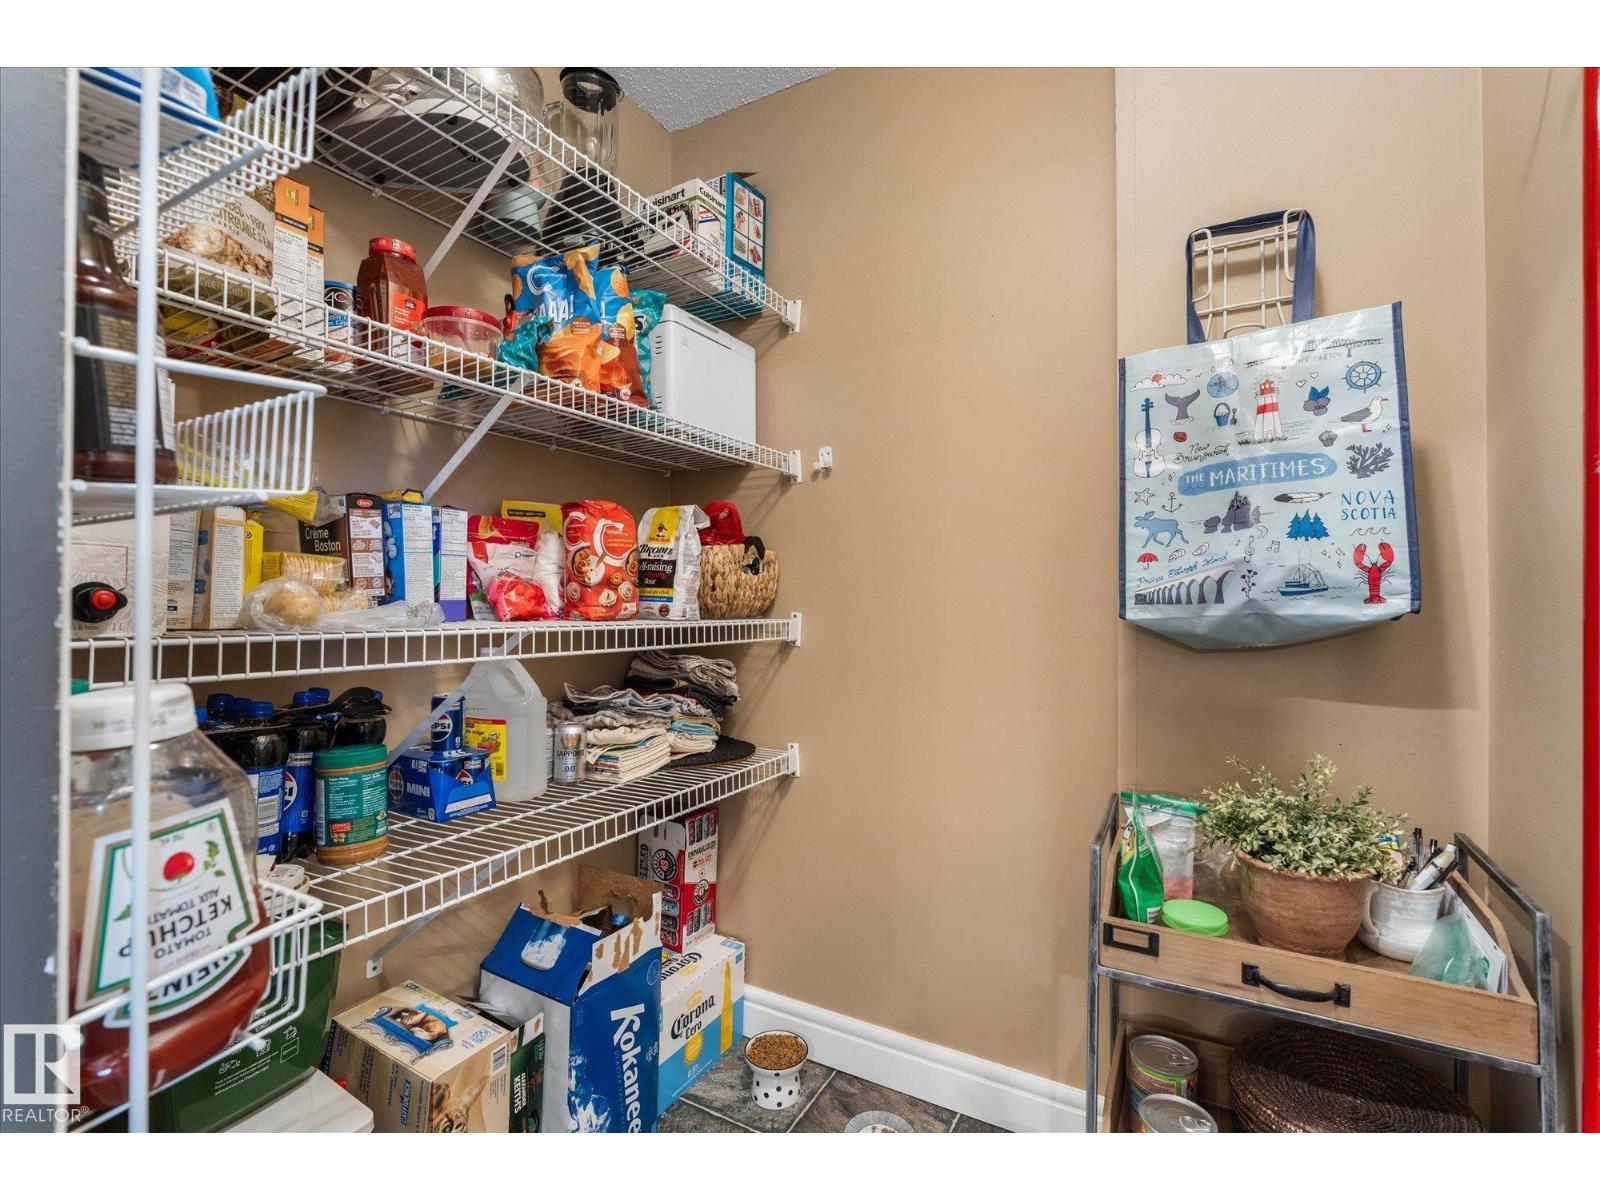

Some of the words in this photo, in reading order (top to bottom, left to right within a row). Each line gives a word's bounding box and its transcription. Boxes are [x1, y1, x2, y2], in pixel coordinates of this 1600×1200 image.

[699, 186, 726, 211] Cuisinart
[1173, 442, 1231, 464] Brunswick
[1189, 443, 1210, 455] New
[1185, 472, 1204, 484] THE
[1209, 456, 1328, 488] MARITIMES
[1341, 489, 1396, 506] NOVA
[1340, 506, 1397, 521] SCOTIA
[304, 527, 329, 540] Crème
[314, 540, 341, 552] Boston
[1136, 573, 1165, 587] Prince
[1167, 561, 1199, 576] Edward
[1201, 552, 1229, 568] Island
[556, 749, 585, 757] SAPPORO
[406, 782, 431, 798] MINI
[196, 887, 220, 904] AUX
[146, 899, 195, 925] TOMAT
[153, 926, 212, 960] TOMATO
[670, 995, 716, 1040] Corona
[685, 1020, 703, 1040] Cero
[610, 1003, 645, 1133] Kokanee
[513, 1074, 521, 1114] KEITH'S
